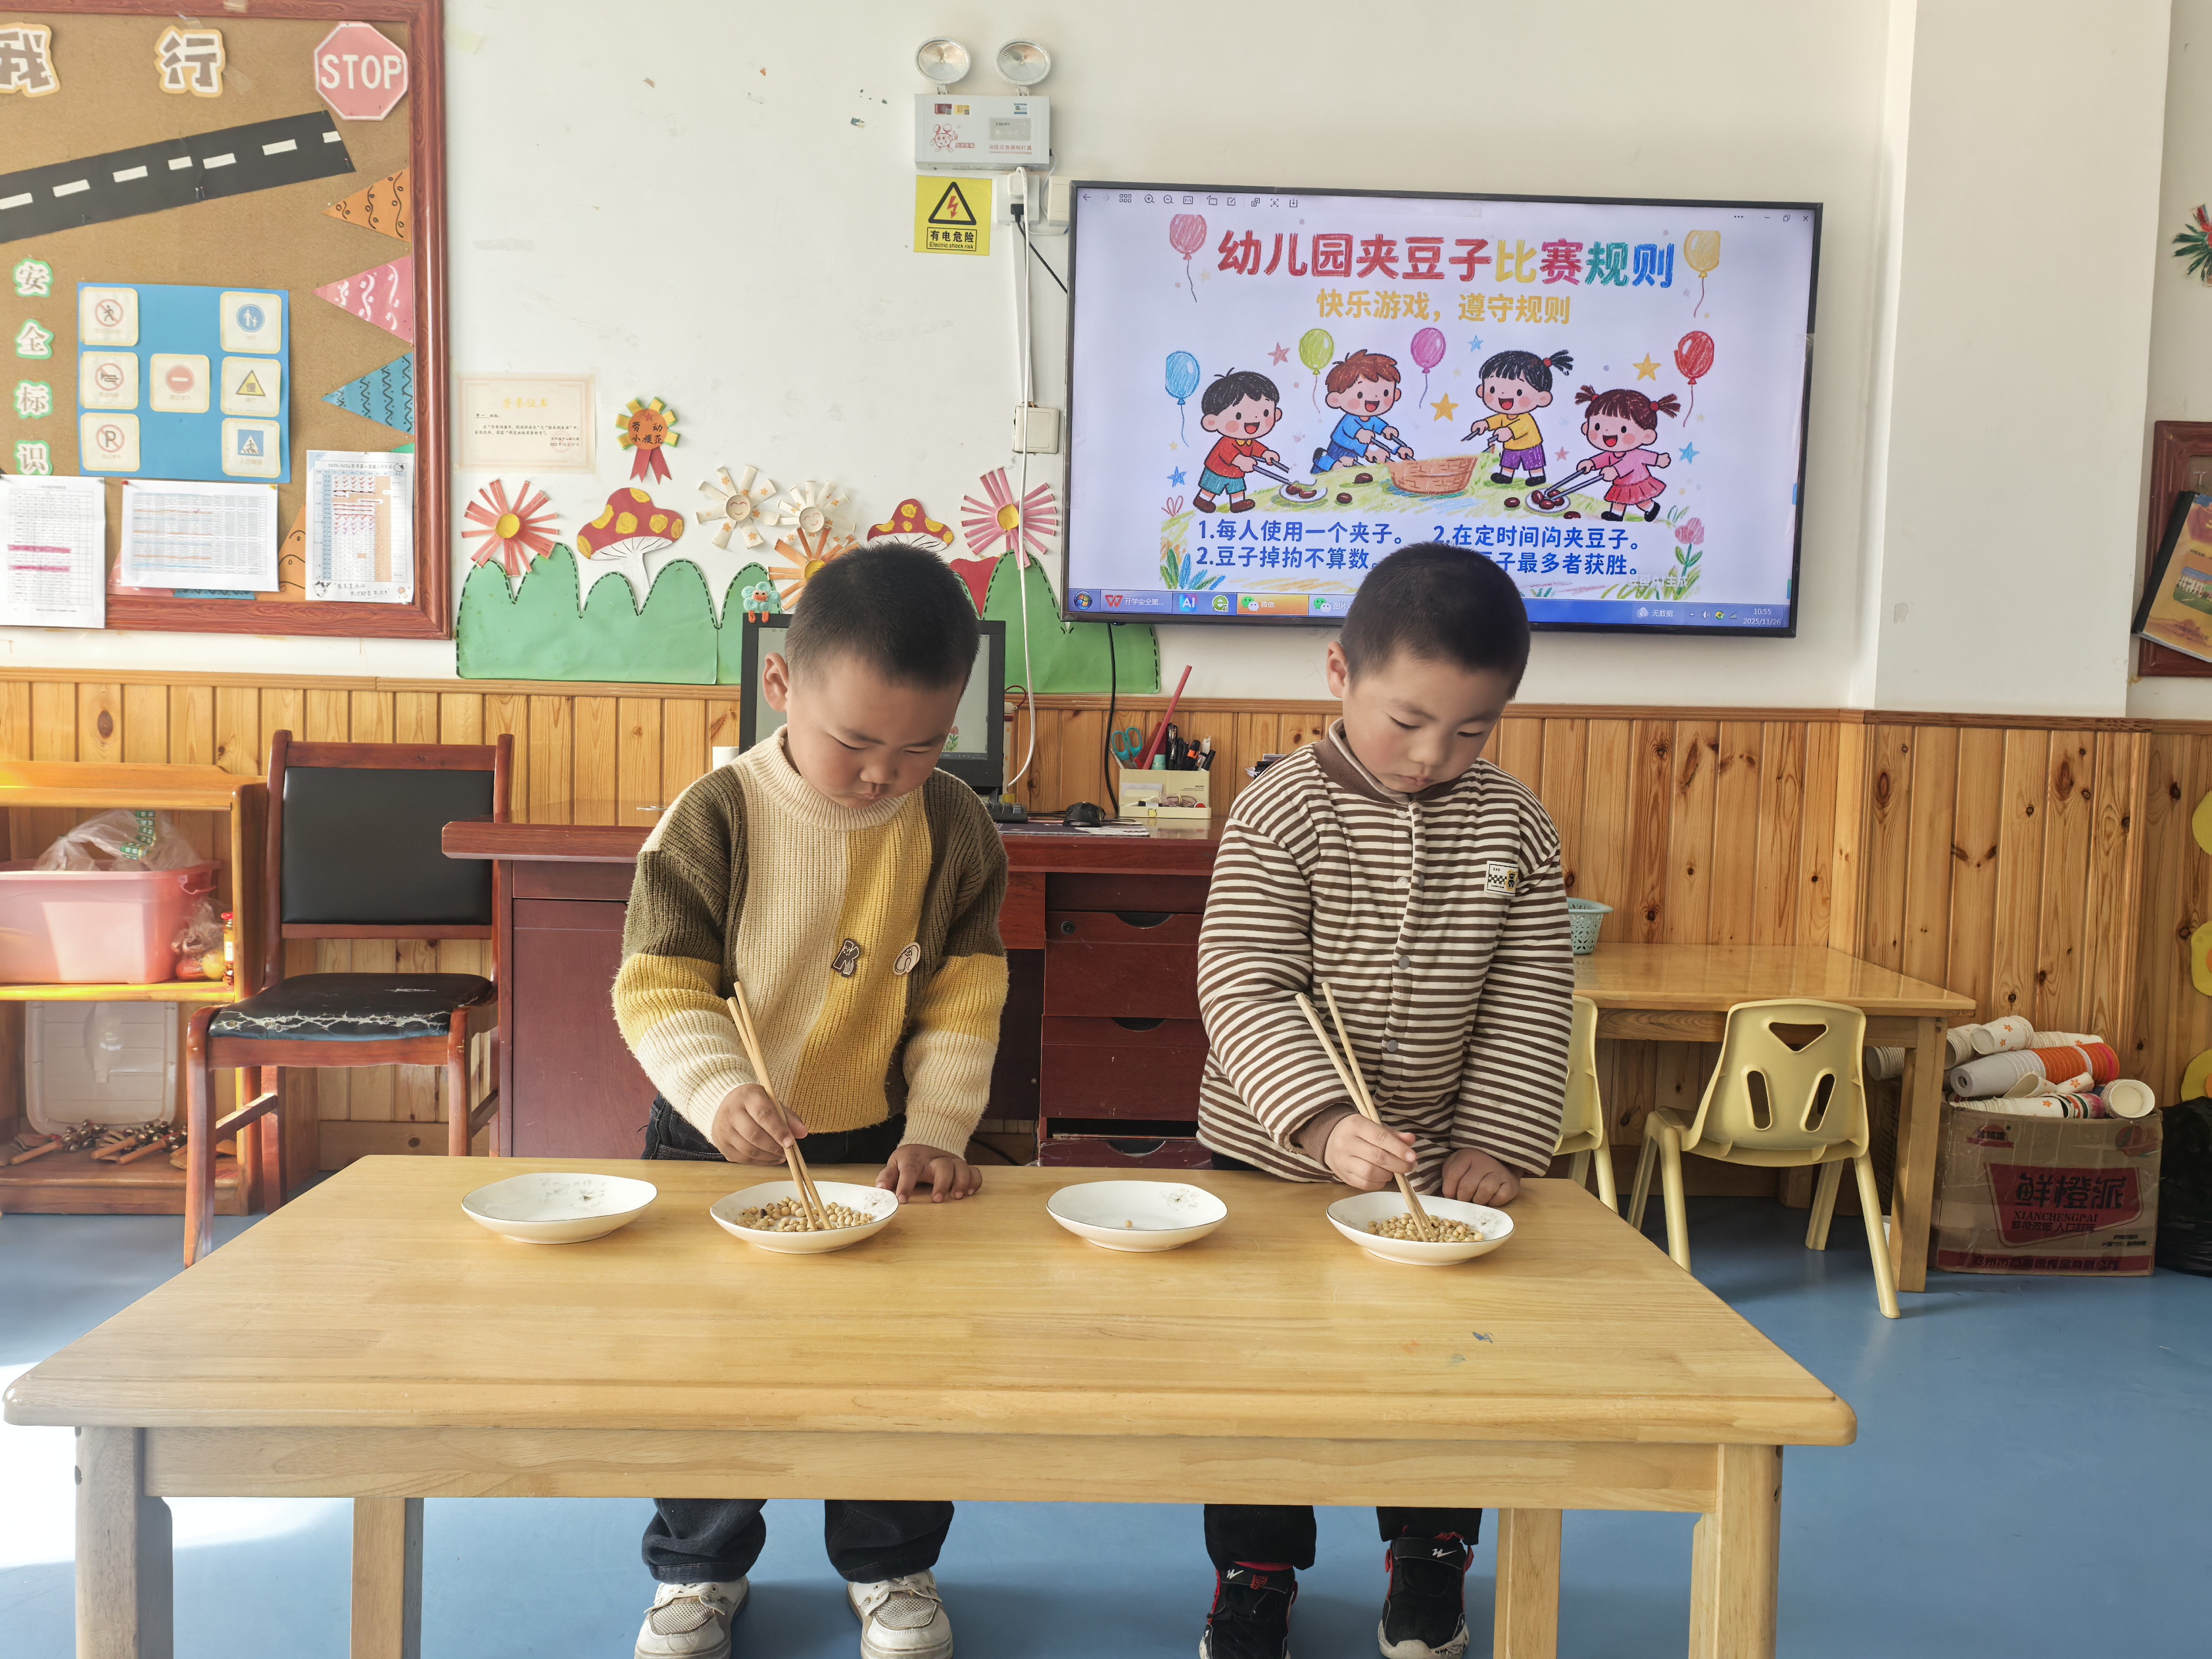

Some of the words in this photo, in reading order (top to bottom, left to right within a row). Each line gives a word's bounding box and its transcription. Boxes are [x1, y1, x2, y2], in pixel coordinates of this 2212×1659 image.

[160, 31, 221, 92] 行
[321, 55, 402, 89] STOP
[930, 230, 974, 242] 有电危险
[1217, 229, 1675, 288] 幼儿园夹豆子比赛规则
[1317, 288, 1570, 324] 快乐游戏，遵守规则
[19, 265, 45, 471] 安全标识
[1198, 519, 1402, 544] 1.每人使用一个夹子。
[1124, 597, 1164, 605] 开学安全第...
[1182, 597, 1195, 608] AI
[2014, 1172, 2127, 1209] 鲜橙派
[2013, 1211, 2099, 1223] XIANCHENGPAI
